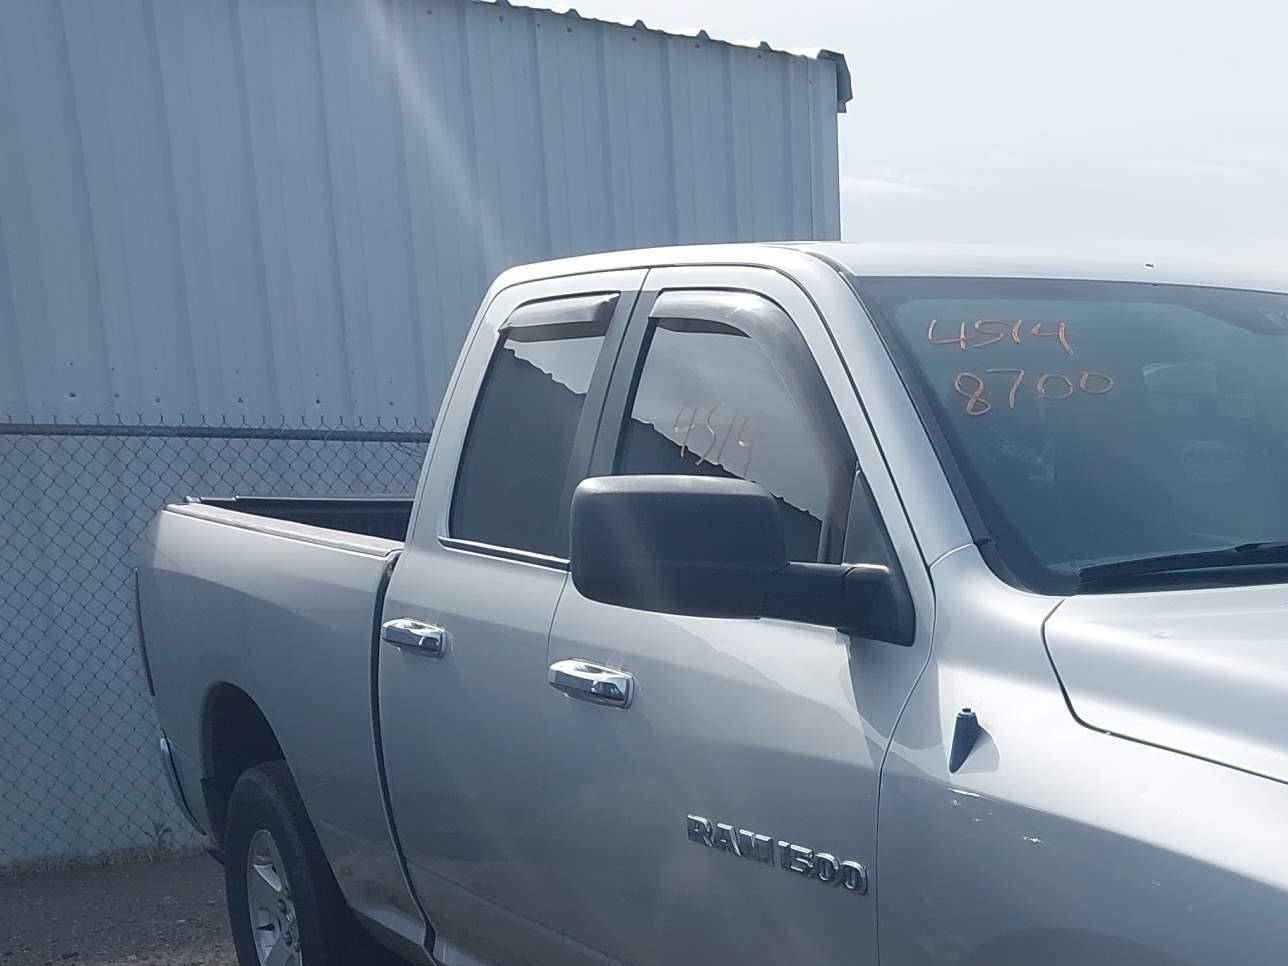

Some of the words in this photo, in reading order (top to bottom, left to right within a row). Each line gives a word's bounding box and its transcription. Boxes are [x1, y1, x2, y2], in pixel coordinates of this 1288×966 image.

[927, 319, 1074, 357] 4514
[953, 368, 1114, 417] 8700
[686, 814, 775, 867] RAM
[777, 840, 869, 896] 1500
